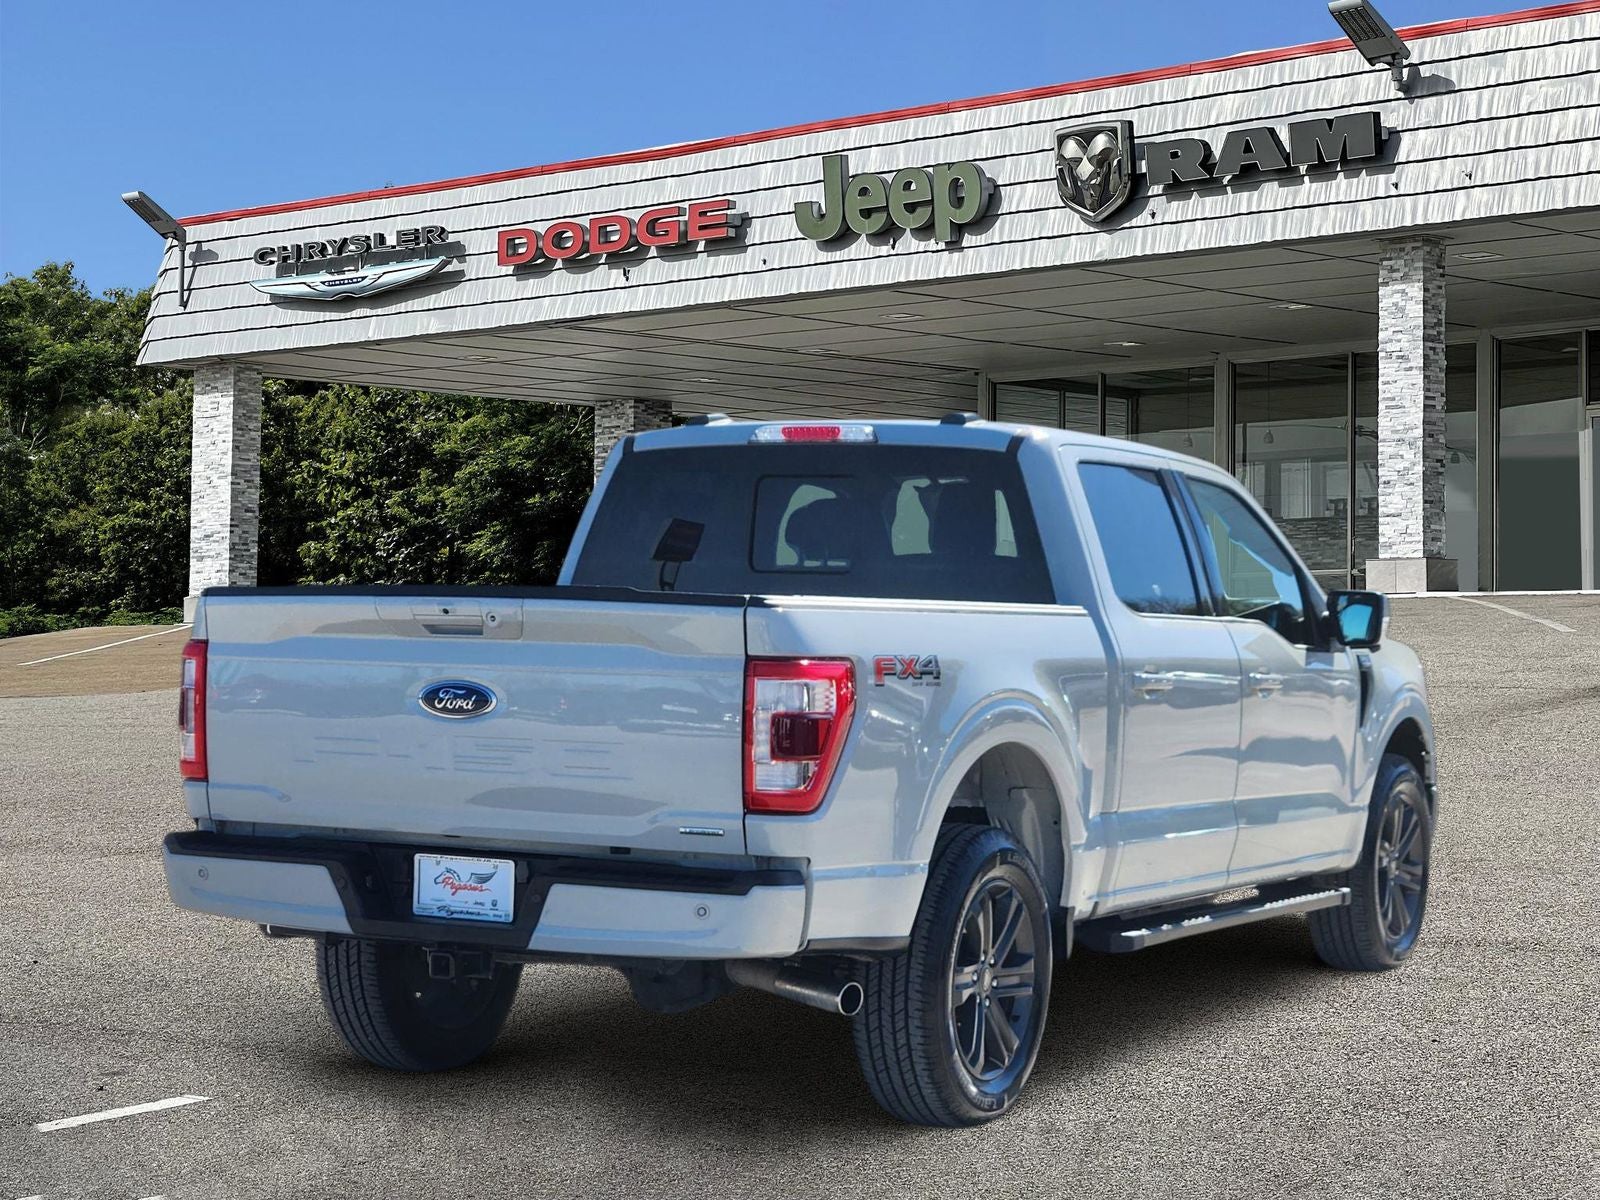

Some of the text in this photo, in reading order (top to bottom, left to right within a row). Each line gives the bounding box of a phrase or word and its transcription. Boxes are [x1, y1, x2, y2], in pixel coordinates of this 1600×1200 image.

[1145, 112, 1380, 187] RAM
[794, 154, 985, 242] Jeep
[253, 225, 449, 266] CHRYSLER
[497, 199, 734, 266] DODGE
[324, 277, 362, 286] CHRYSLER
[873, 655, 941, 687] FX4
[434, 687, 477, 710] Ford
[441, 876, 492, 896] Pegasus
